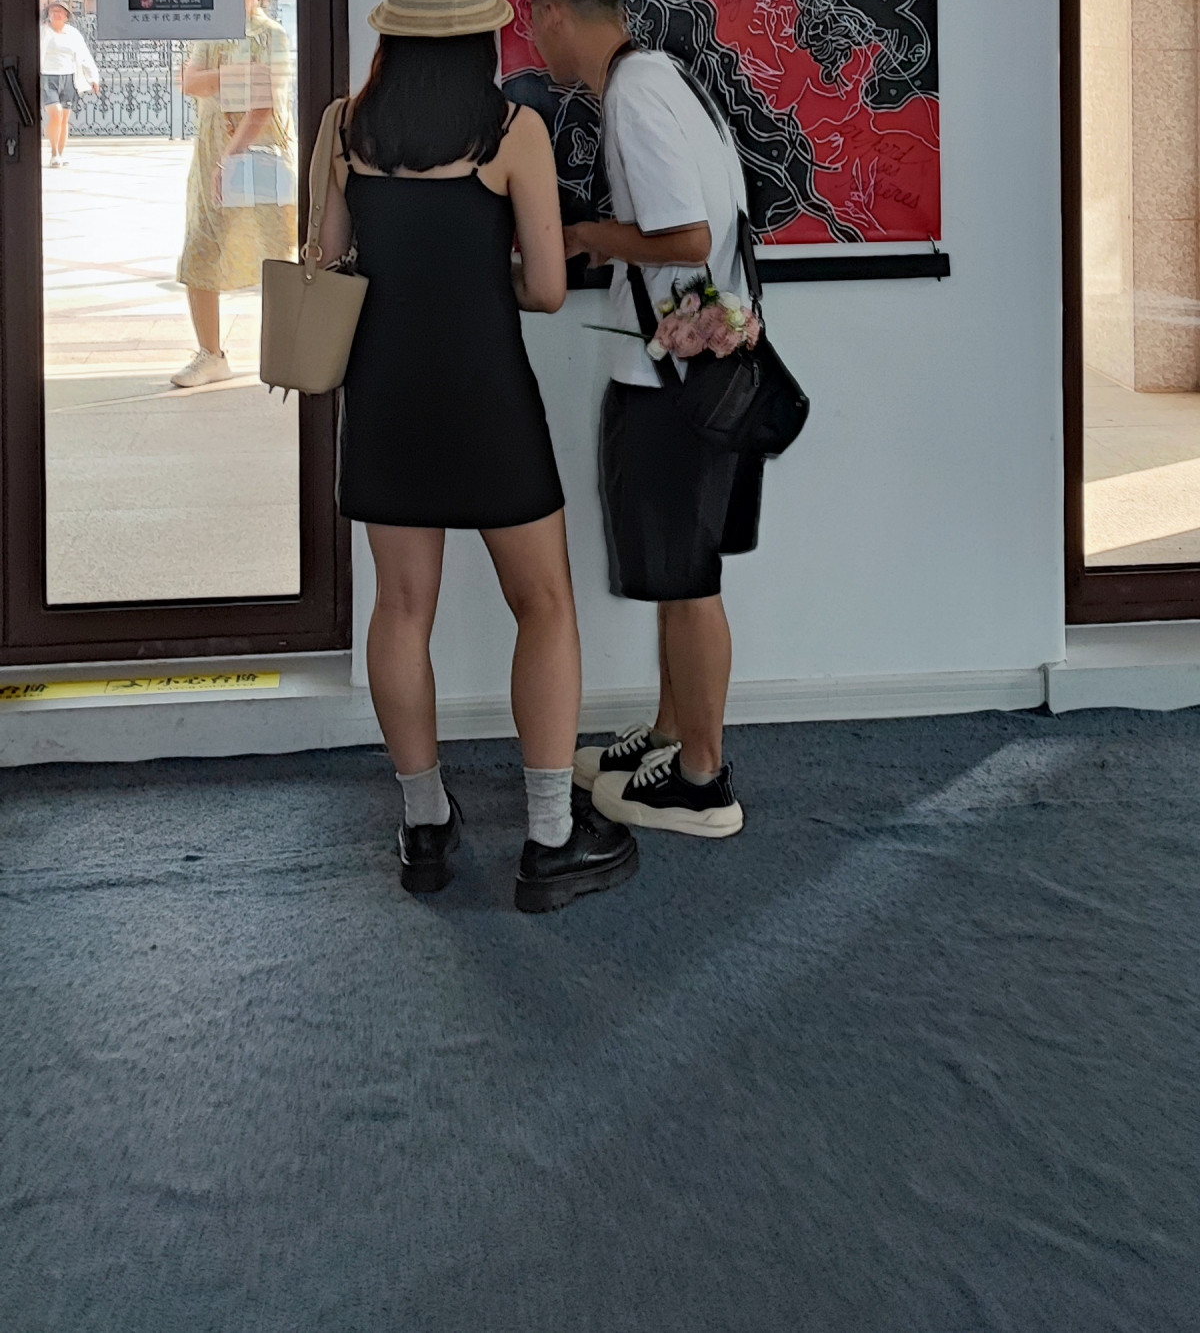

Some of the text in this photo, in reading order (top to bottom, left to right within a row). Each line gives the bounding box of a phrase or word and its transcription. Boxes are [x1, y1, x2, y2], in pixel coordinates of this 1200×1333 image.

[130, 13, 212, 22] 大连千代美术学校
